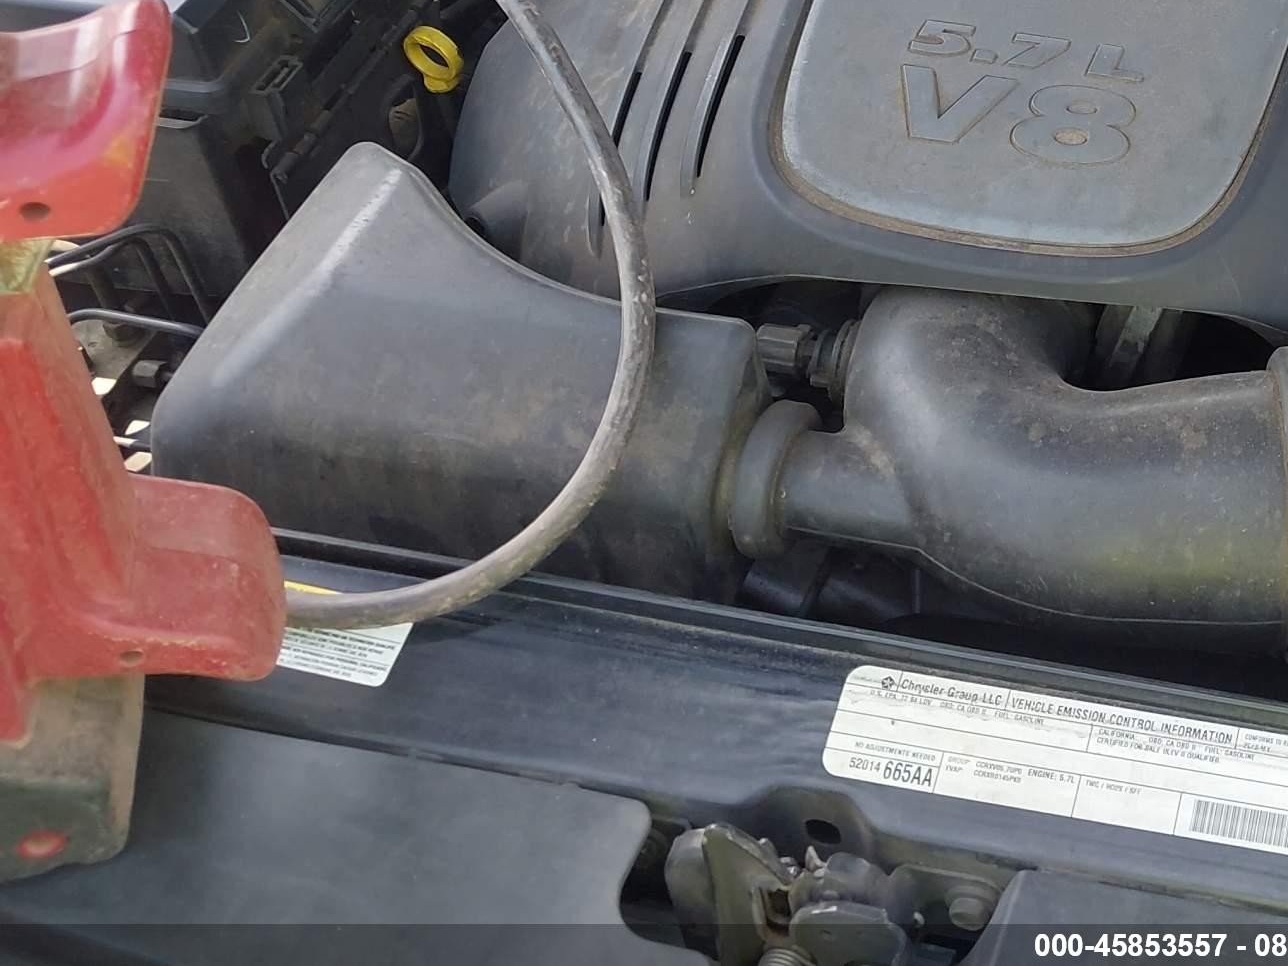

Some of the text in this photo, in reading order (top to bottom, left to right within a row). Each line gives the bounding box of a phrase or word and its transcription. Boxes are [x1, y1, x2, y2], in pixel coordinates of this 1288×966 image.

[900, 64, 1138, 166] V8
[900, 678, 1003, 706] Chrysler Group LLC
[1011, 697, 1233, 743] VEHICLE EMISSION CONTROL INFORMATION
[911, 751, 936, 762] NEEDED
[848, 756, 933, 787] 52014 665AA
[1027, 768, 1075, 784] ENGINE: 5.7L
